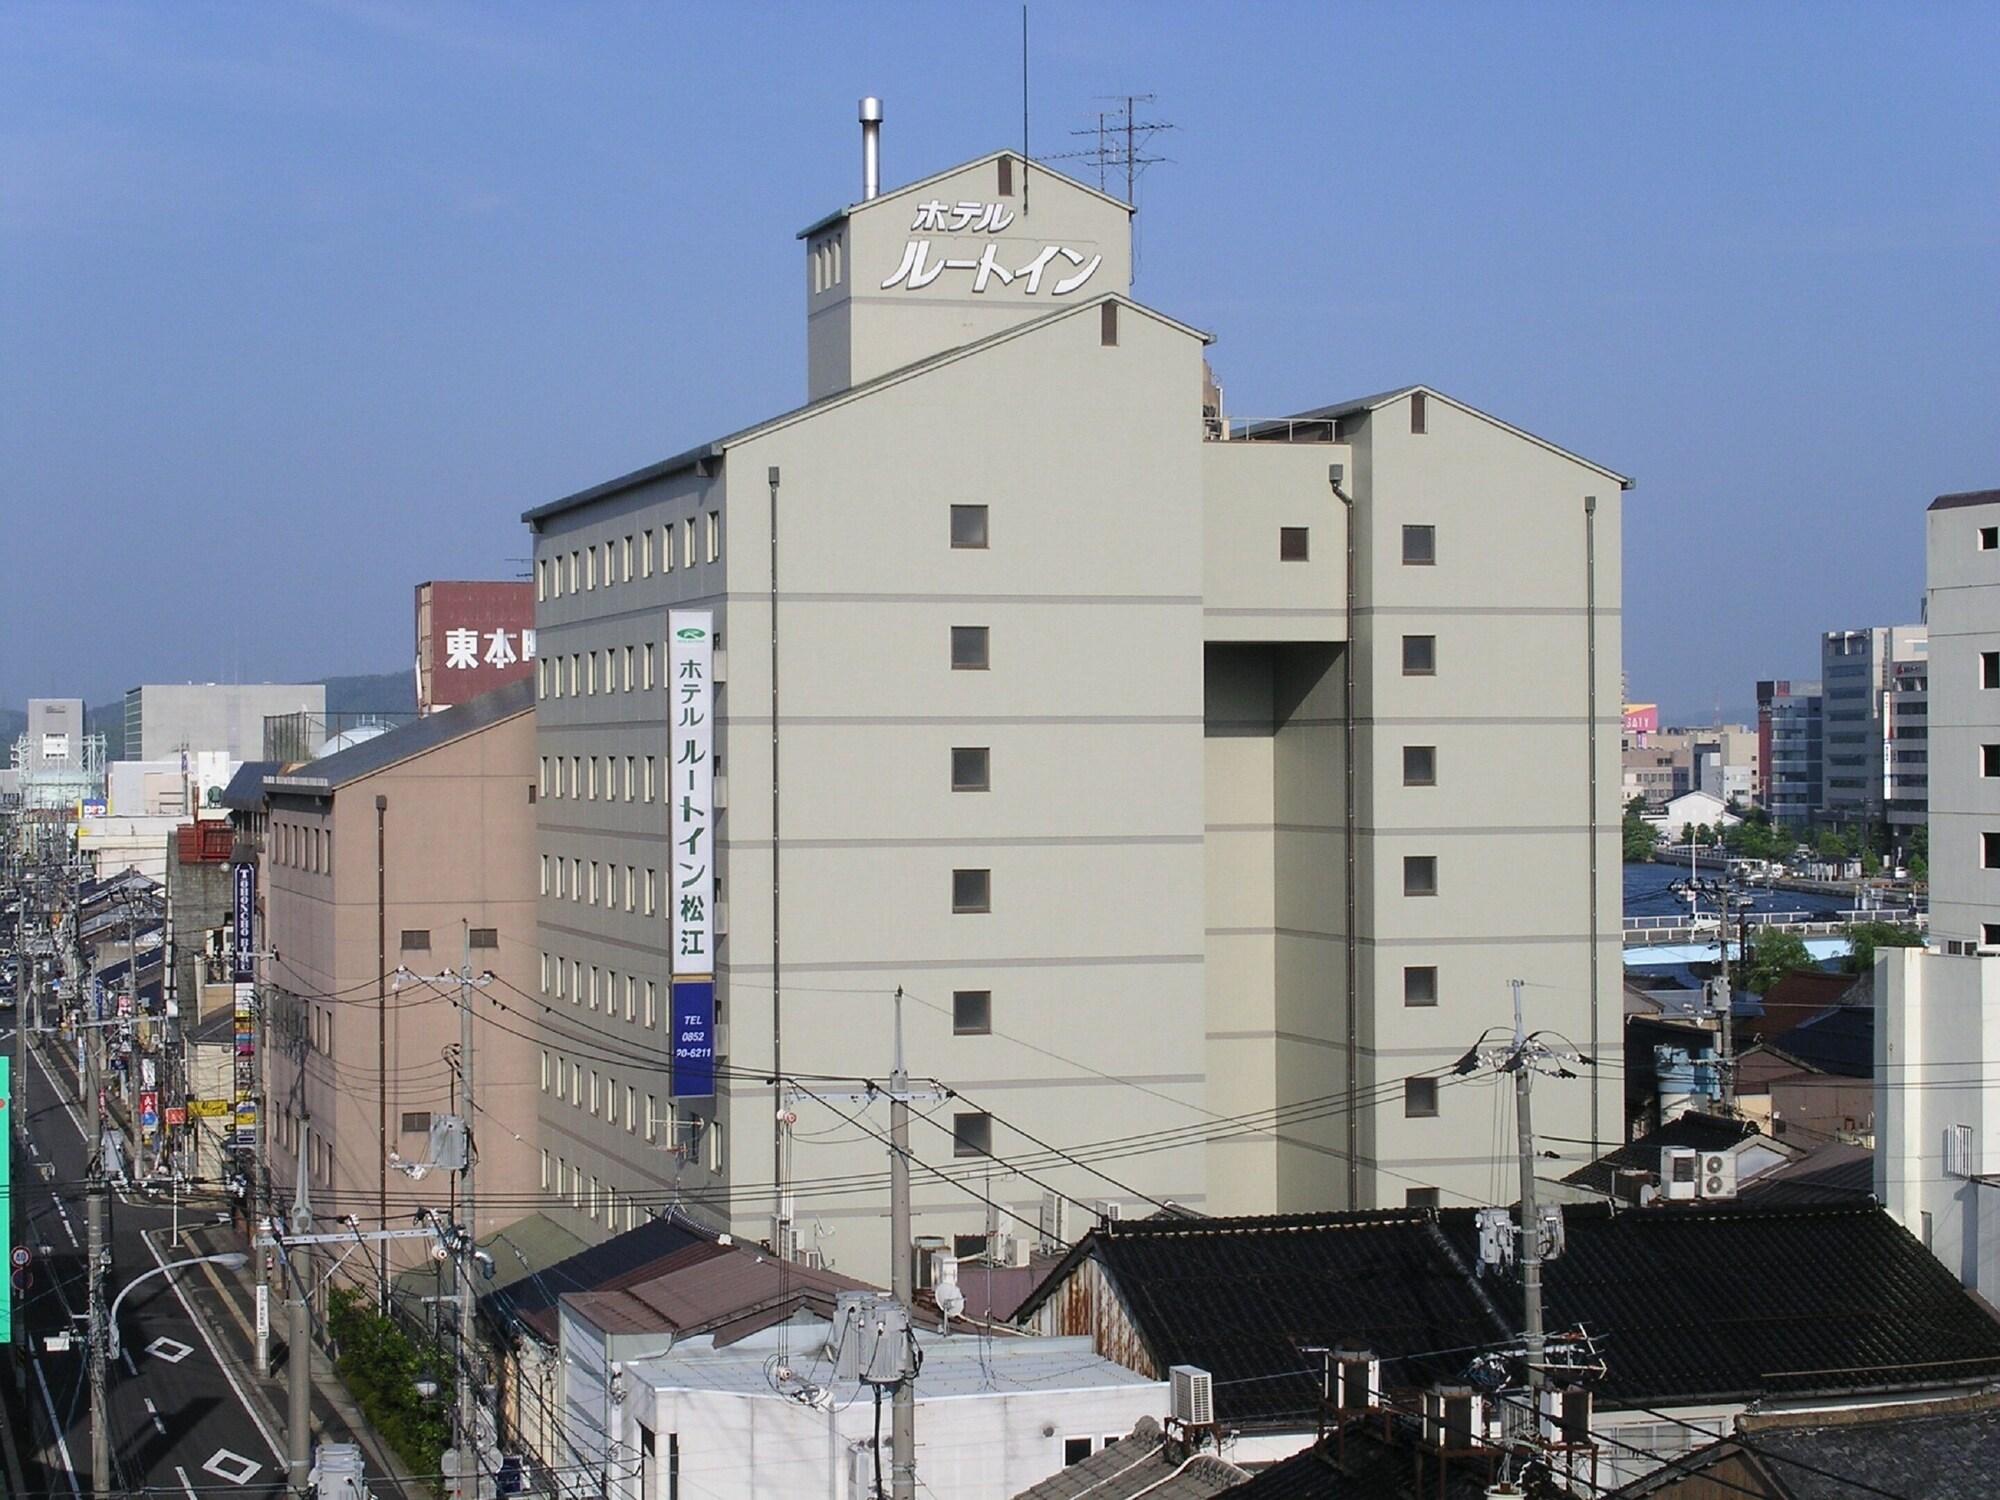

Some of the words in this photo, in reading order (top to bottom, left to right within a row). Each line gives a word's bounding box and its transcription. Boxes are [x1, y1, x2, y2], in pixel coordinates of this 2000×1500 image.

[911, 200, 1015, 233] ホテル
[881, 240, 1102, 295] ルートイン
[684, 1015, 703, 1025] TEL
[681, 1031, 705, 1042] 0852
